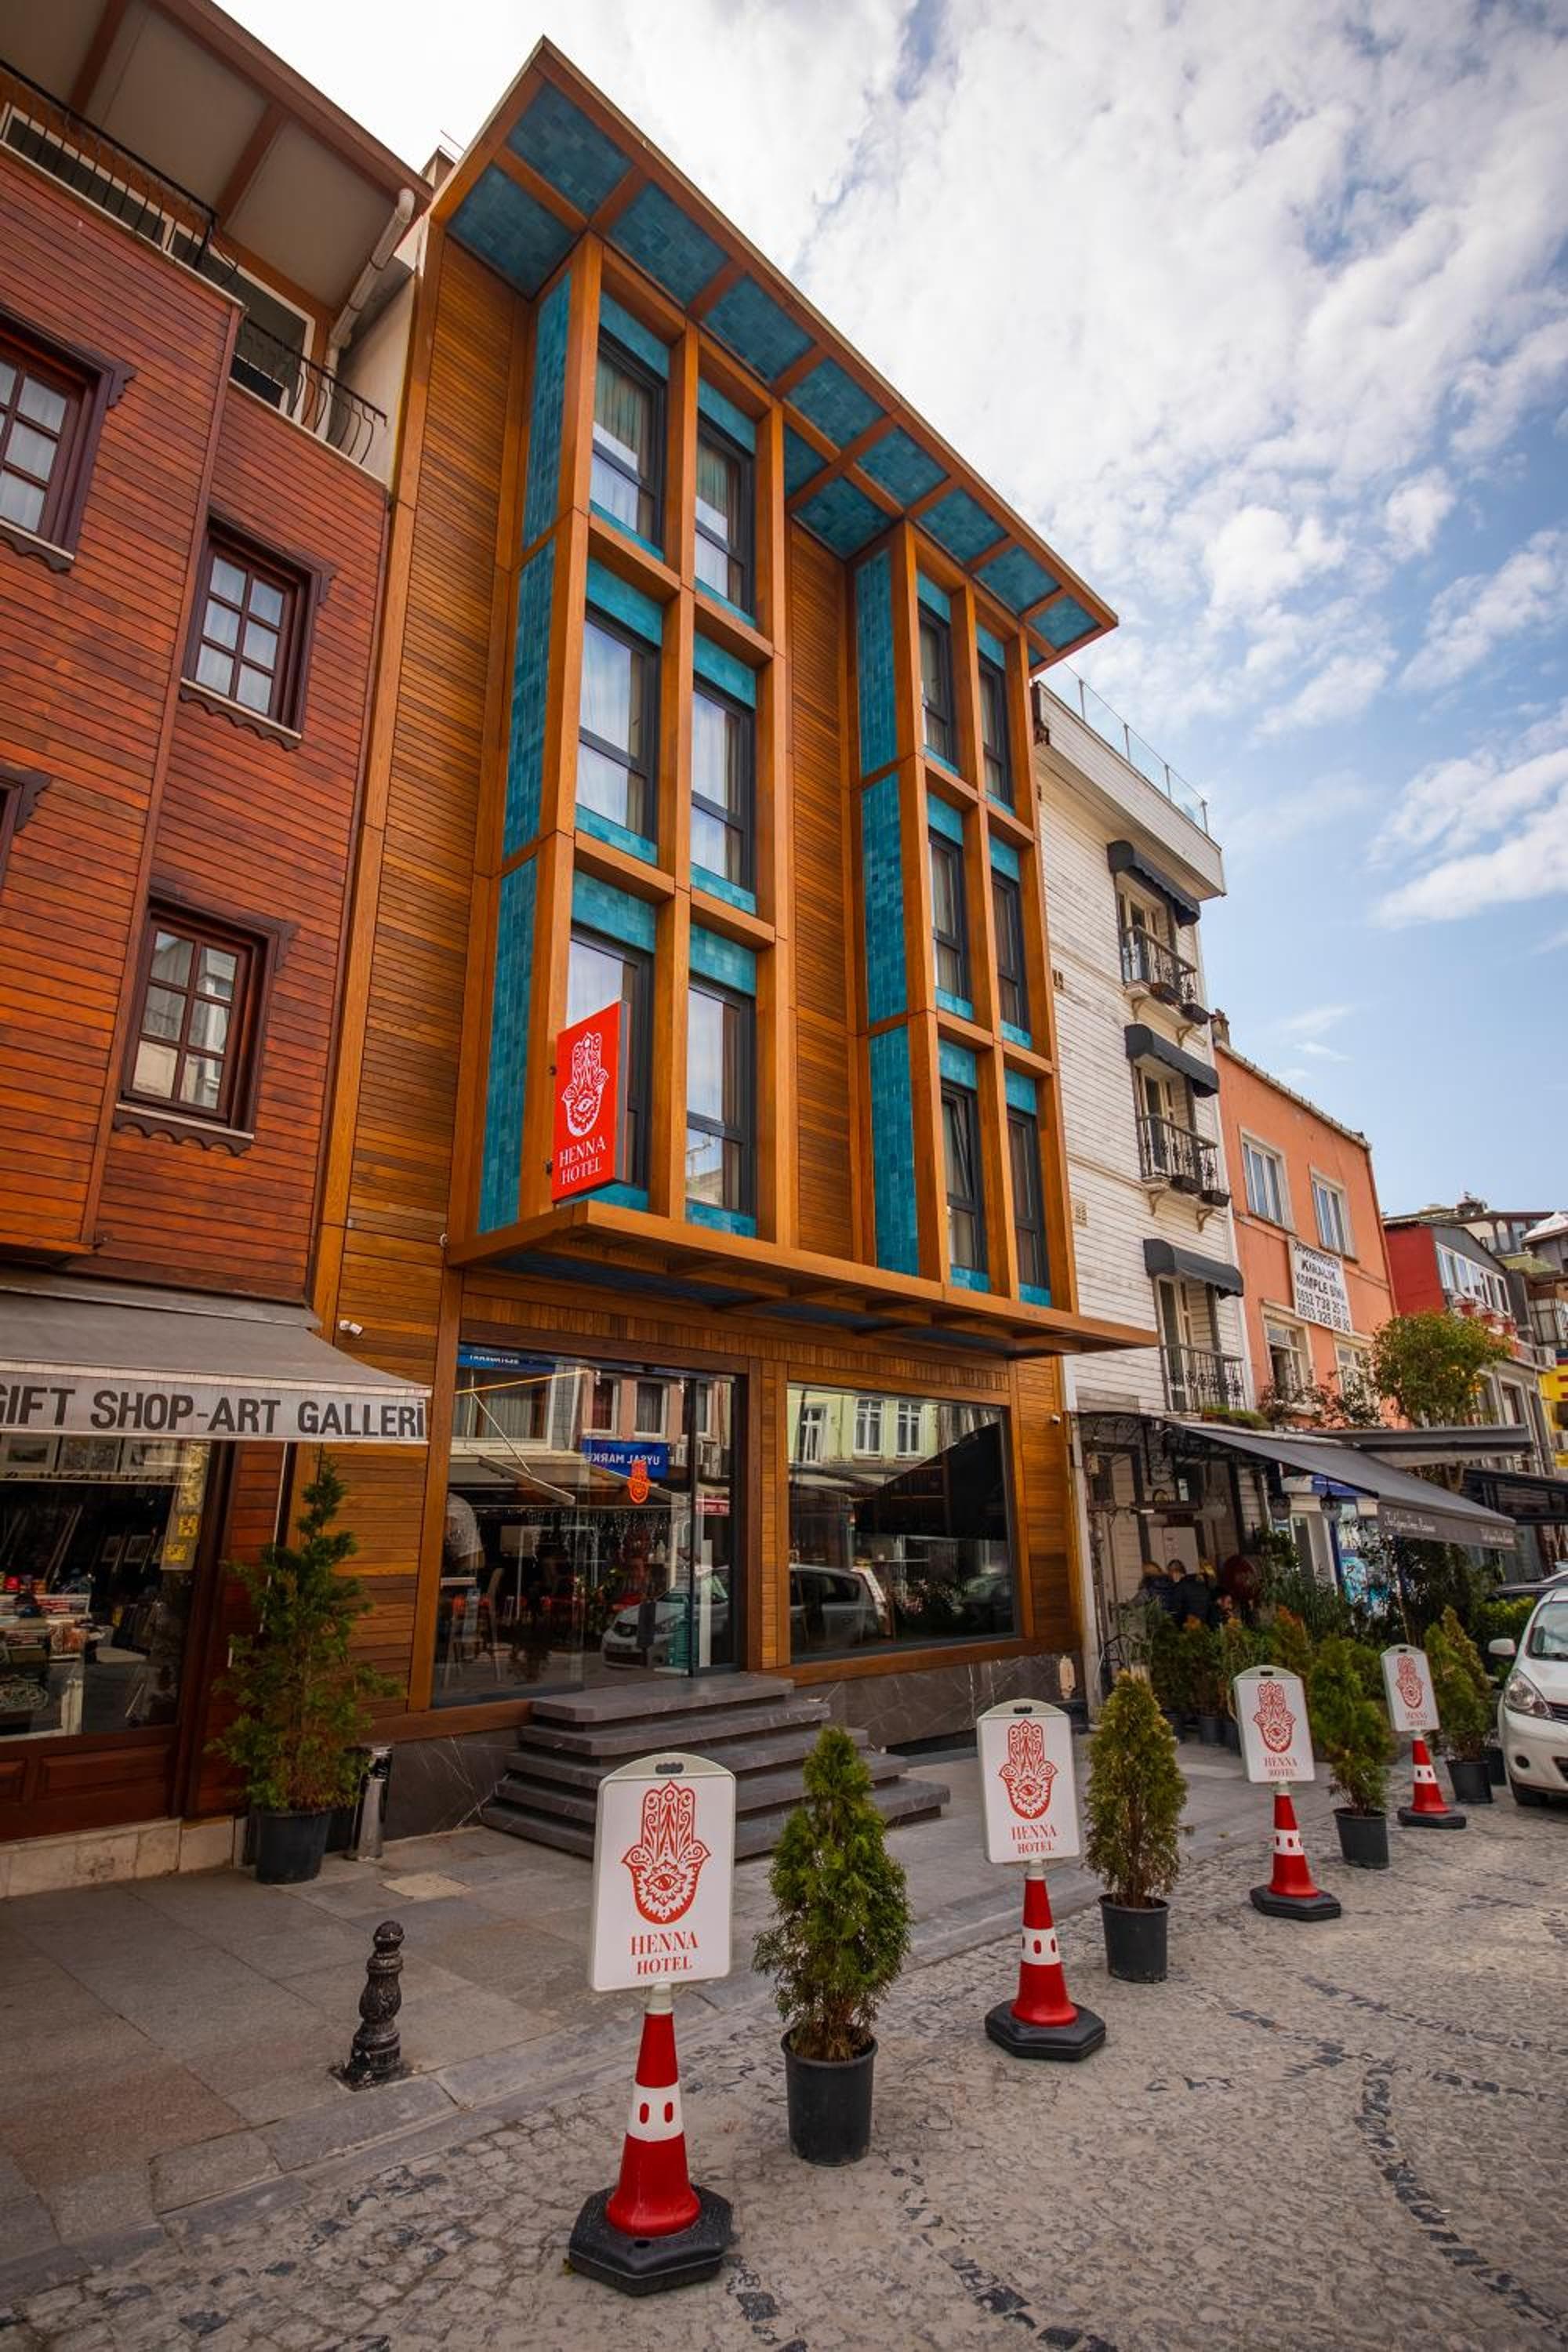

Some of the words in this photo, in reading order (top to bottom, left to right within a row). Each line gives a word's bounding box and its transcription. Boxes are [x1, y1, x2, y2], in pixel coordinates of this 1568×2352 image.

[559, 1136, 606, 1167] HENNA
[561, 1156, 602, 1185] HOTEL
[297, 1400, 424, 1438] GALLERİ
[1265, 1757, 1298, 1767] HENNA
[1011, 1824, 1057, 1840] HENNA
[1018, 1840, 1054, 1853] HOTEL
[630, 1931, 699, 1955] HENNA
[637, 1956, 693, 1975] HOTEL
